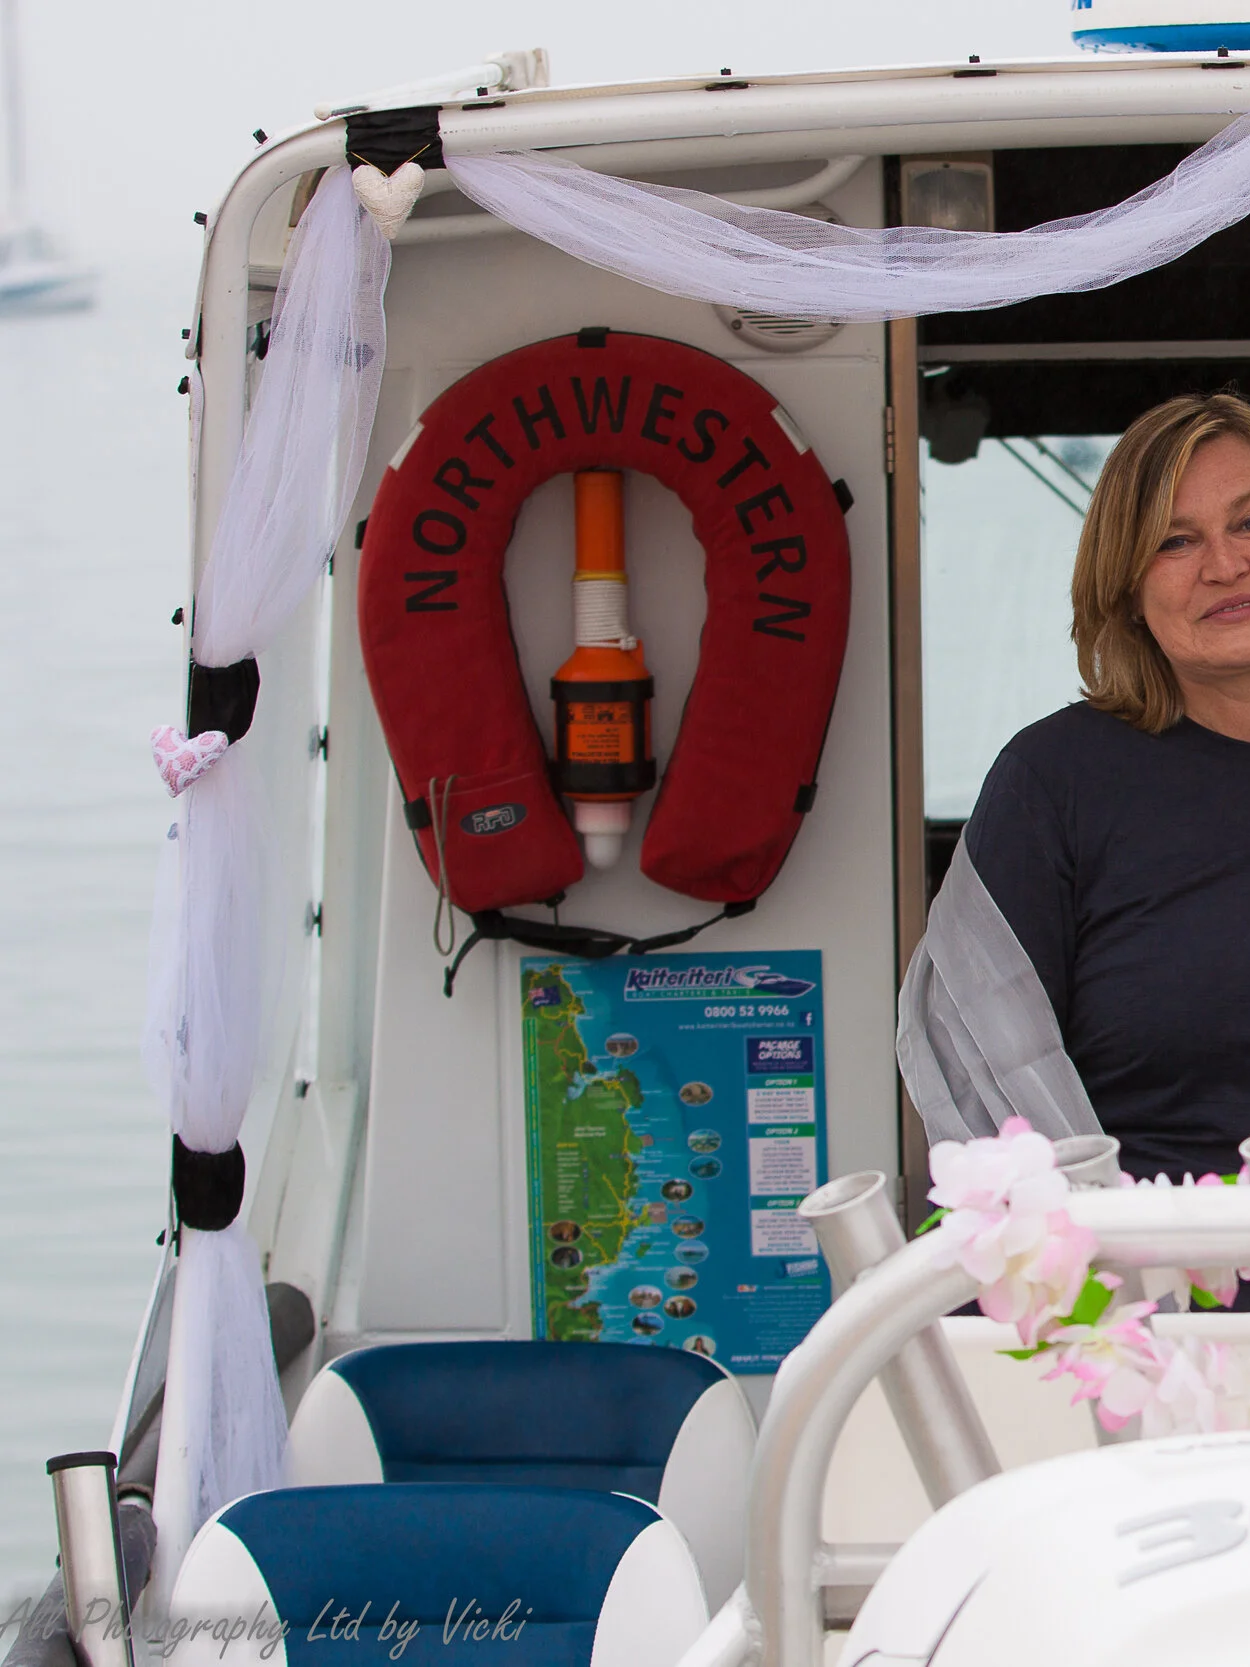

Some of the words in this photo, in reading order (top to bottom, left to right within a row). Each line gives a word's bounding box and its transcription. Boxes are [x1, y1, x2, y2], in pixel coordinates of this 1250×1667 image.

[403, 374, 812, 646] NORTHWESTERN
[626, 966, 734, 991] Kaiteriteri
[660, 989, 707, 998] CHARTERS
[704, 1006, 735, 1018] 0800
[739, 1006, 755, 1018] 52
[758, 1005, 790, 1016] 9966
[758, 1040, 800, 1051] PACKAGE
[758, 1051, 802, 1060] OPTIONS
[765, 1079, 793, 1087] OPTION
[765, 1128, 793, 1136] OPTION
